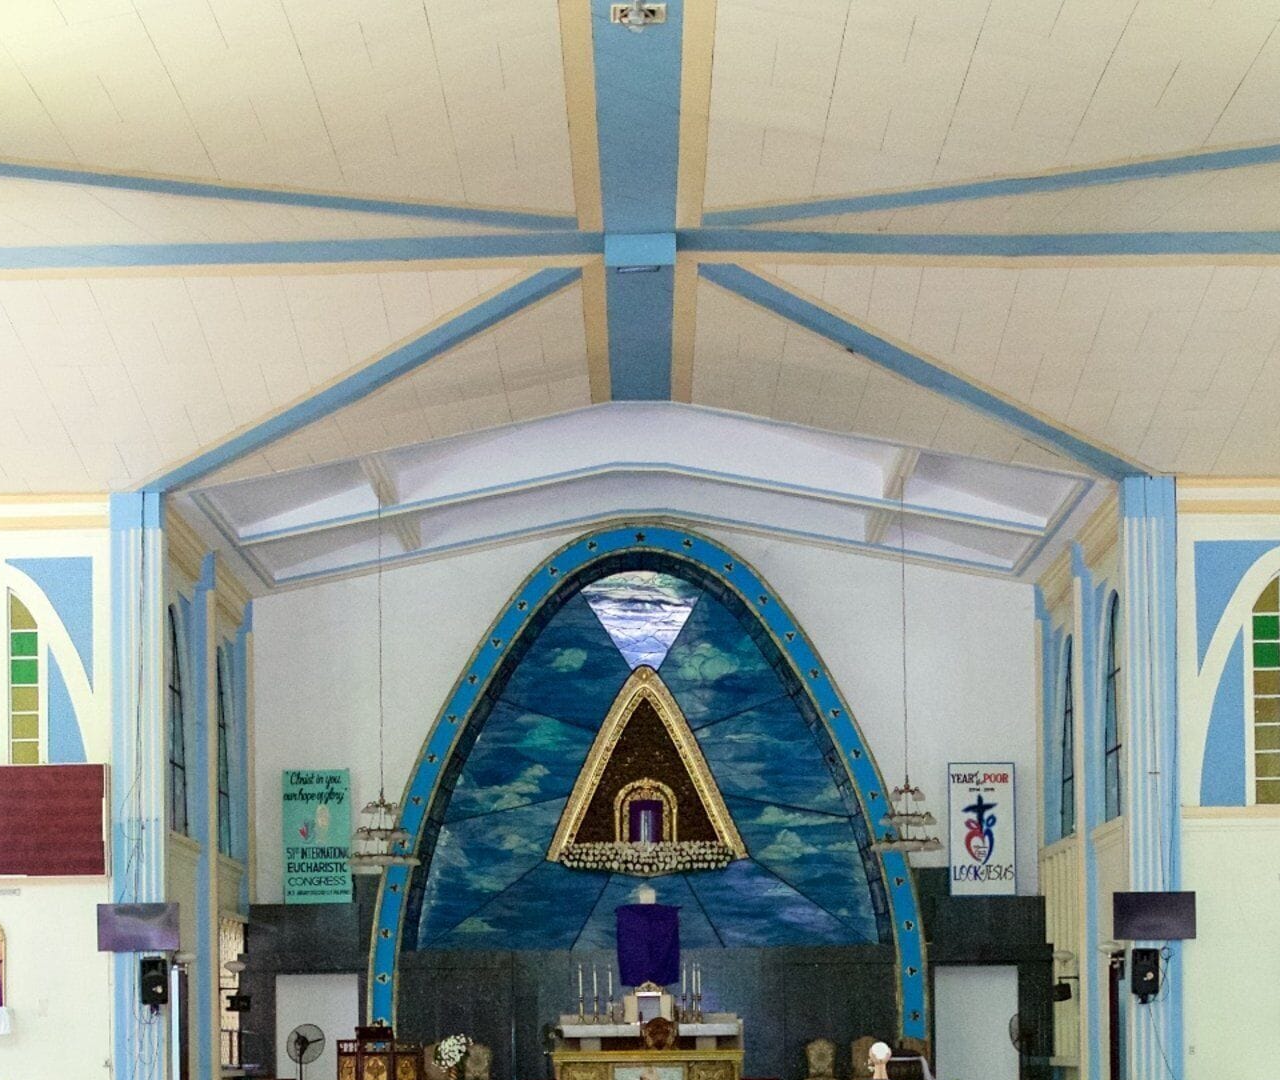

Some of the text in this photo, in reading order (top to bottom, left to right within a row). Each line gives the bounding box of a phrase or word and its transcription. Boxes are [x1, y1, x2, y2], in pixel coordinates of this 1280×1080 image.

[951, 773, 974, 784] YEAR
[983, 772, 1008, 784] POOR
[287, 862, 347, 873] EUCHARISTIC
[981, 864, 1014, 882] JESUS
[287, 876, 346, 887] CONGRESS
